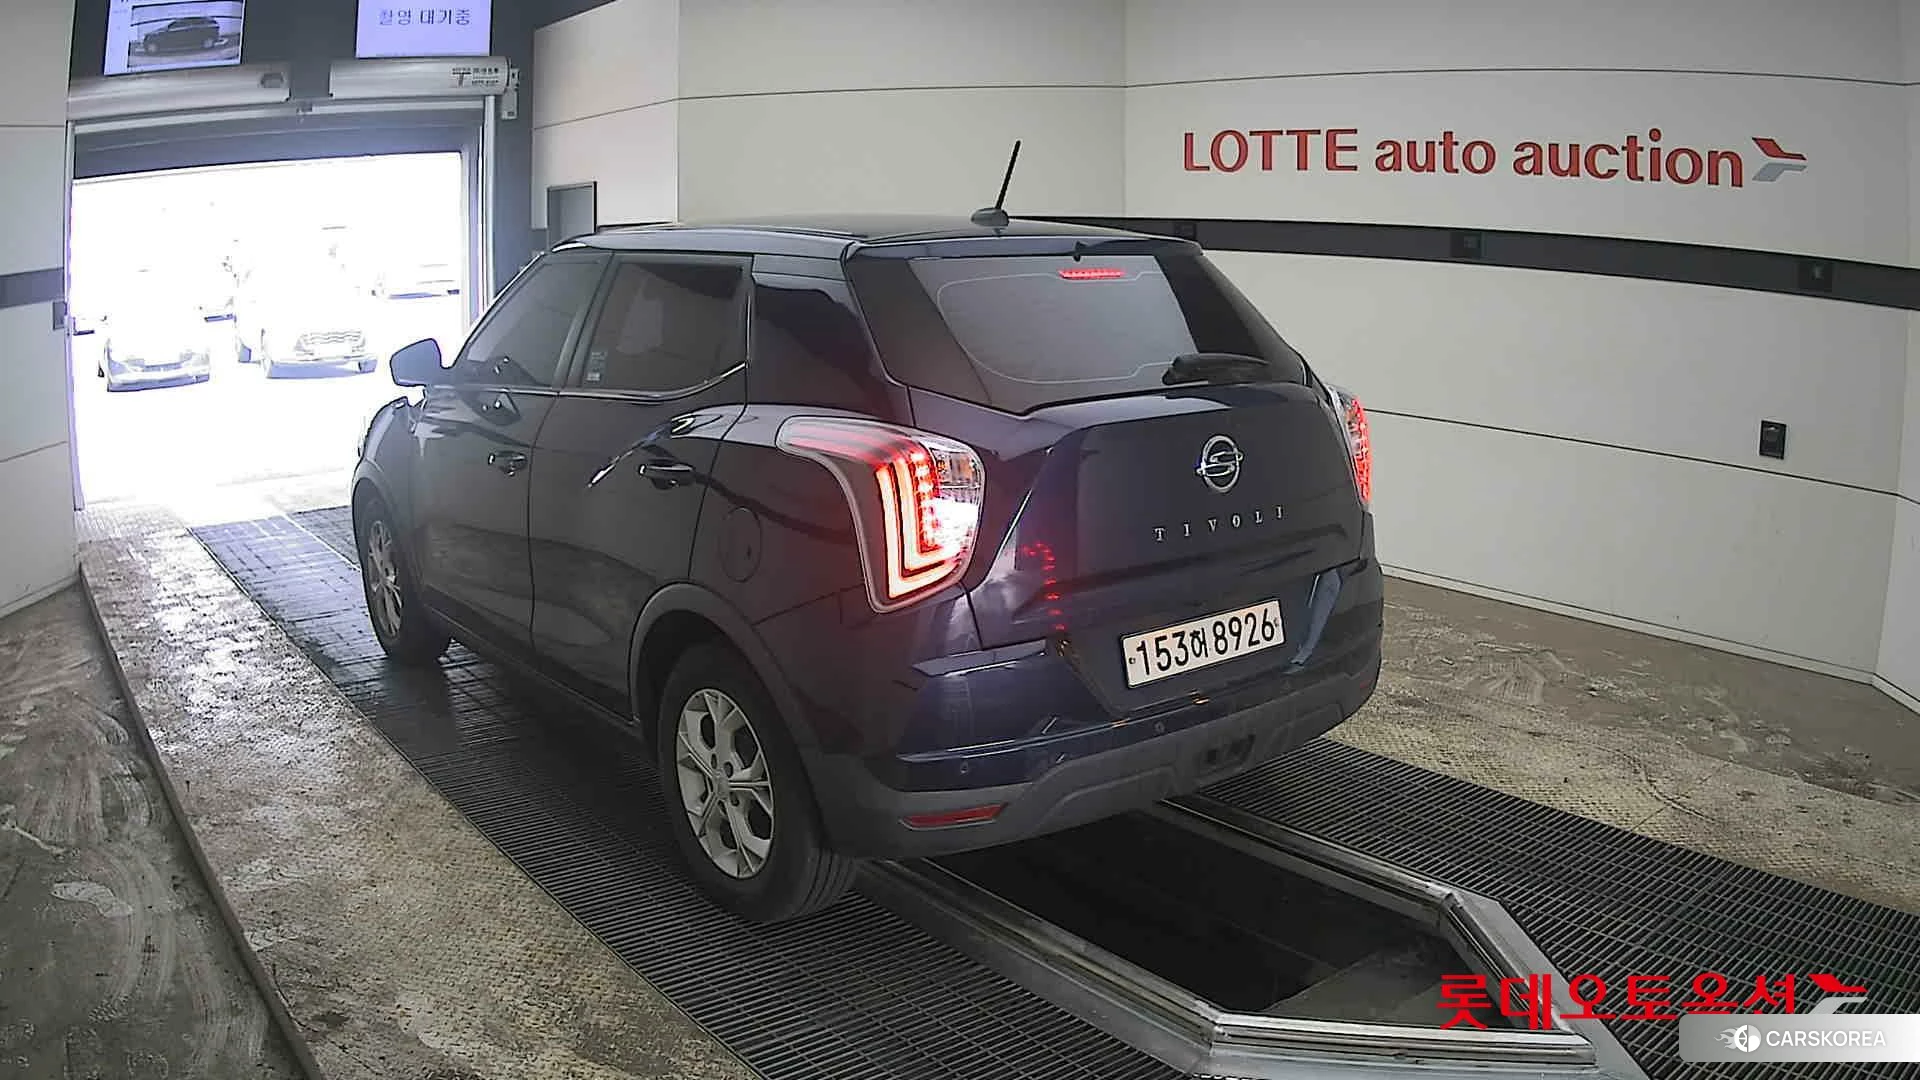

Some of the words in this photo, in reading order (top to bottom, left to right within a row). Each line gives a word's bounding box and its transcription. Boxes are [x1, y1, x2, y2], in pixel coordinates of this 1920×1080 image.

[420, 8, 471, 26] 대기중
[1184, 128, 1358, 172] LOTTE
[1374, 130, 1496, 173] auto
[1512, 128, 1744, 188] auction
[1153, 505, 1286, 542] TIVOLI
